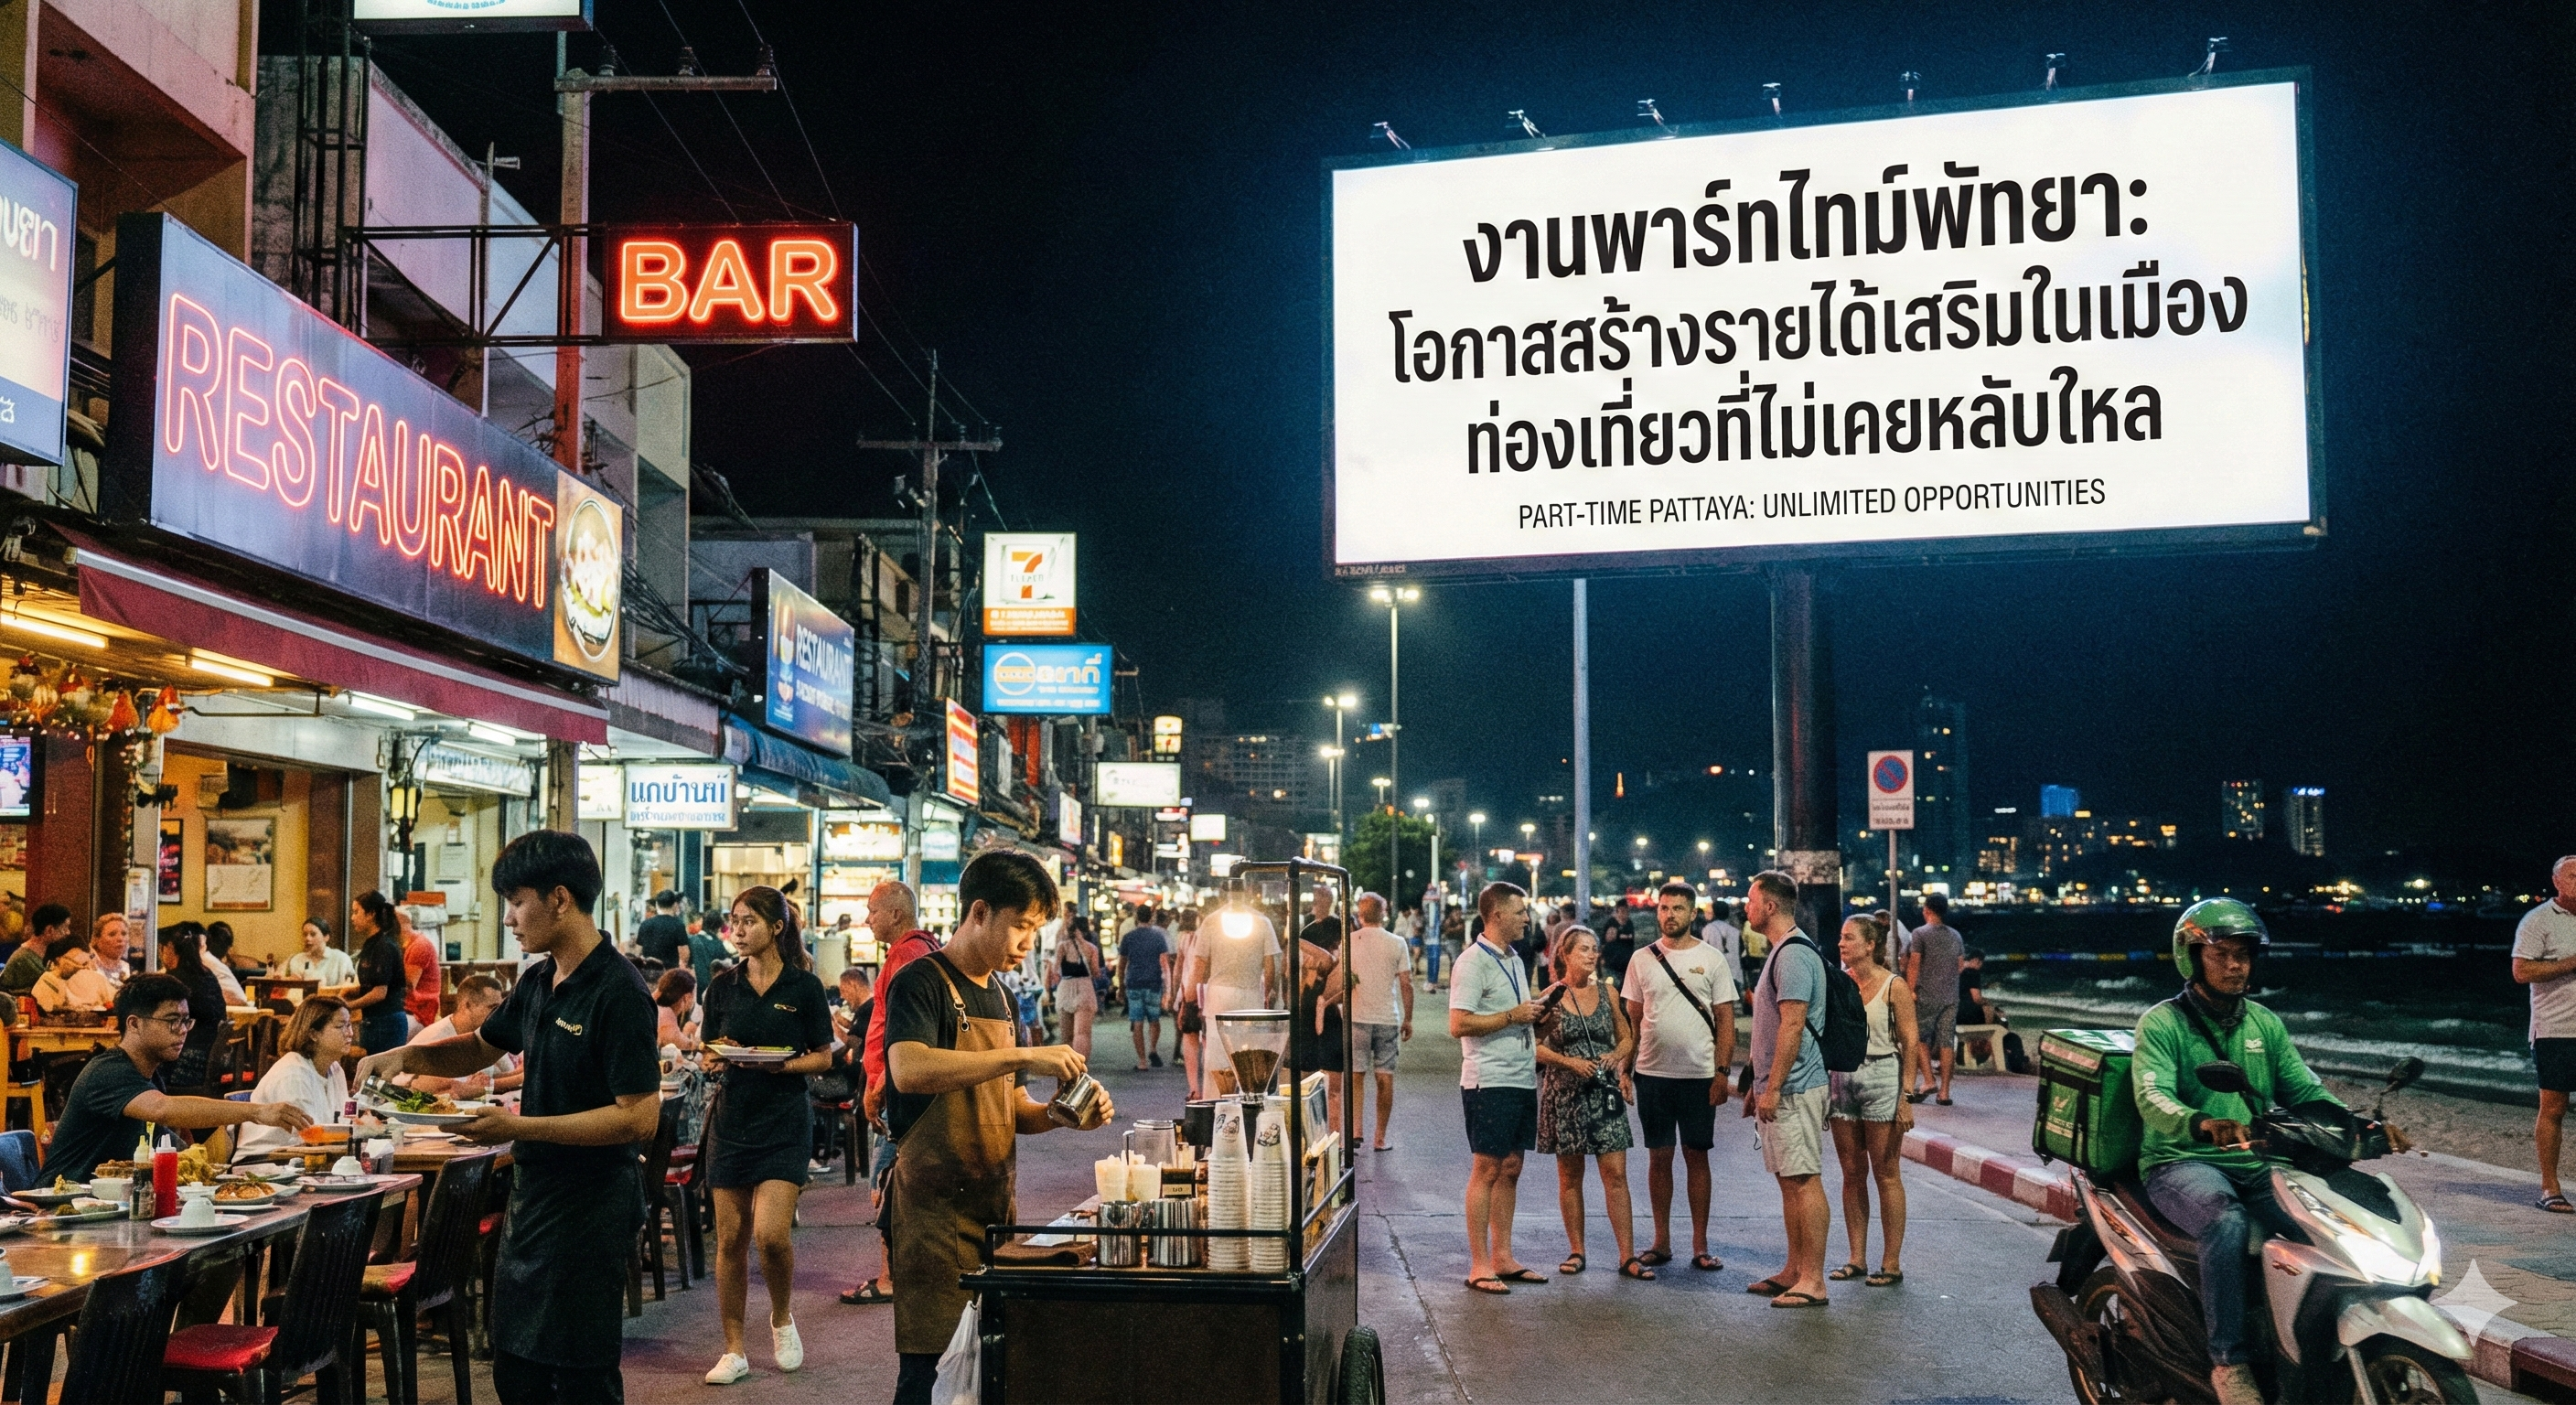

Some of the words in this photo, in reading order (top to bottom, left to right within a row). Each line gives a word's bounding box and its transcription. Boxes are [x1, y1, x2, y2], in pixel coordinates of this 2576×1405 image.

[1462, 160, 2148, 283] งานพาร์ทไทม์พัทยา:
[621, 240, 839, 321] BAR
[1388, 259, 2248, 383] โอกาสสร้างรายได้เสริมในเมือง
[165, 293, 555, 609] RESTAURANT
[1467, 365, 2162, 474] ท่องเที่ยวที่ไม่เคยหลับใหล
[1519, 499, 1642, 530] PART-TIME
[1650, 495, 1757, 523] PATTAYA:
[1764, 488, 1895, 519] UNLIMITED
[1905, 477, 2106, 513] OPPORTUNITIES
[796, 622, 852, 692] RESTAURANT
